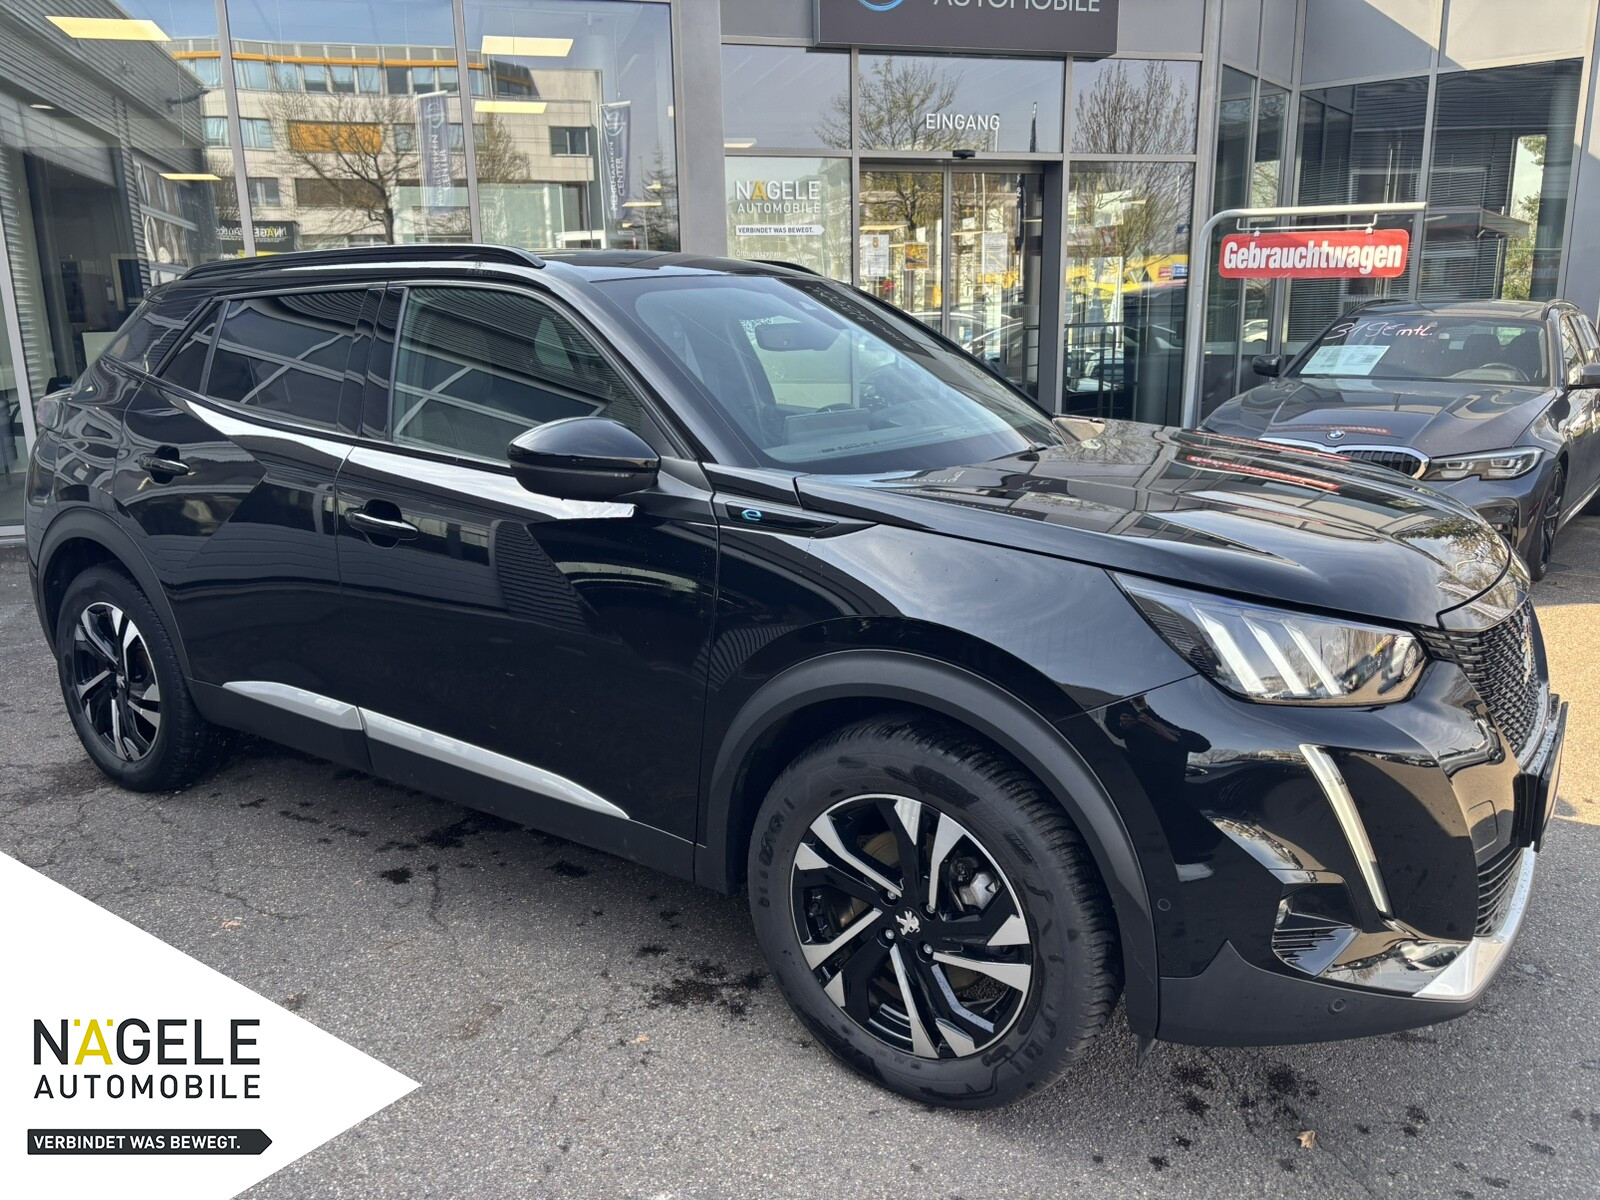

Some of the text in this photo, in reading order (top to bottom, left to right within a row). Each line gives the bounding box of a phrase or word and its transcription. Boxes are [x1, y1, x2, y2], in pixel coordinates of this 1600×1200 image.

[933, 0, 1100, 12] OBILE
[926, 113, 1000, 131] EINGANG
[737, 202, 821, 214] AUTOMOBILE
[1223, 240, 1403, 275] Gebrauchtwagen
